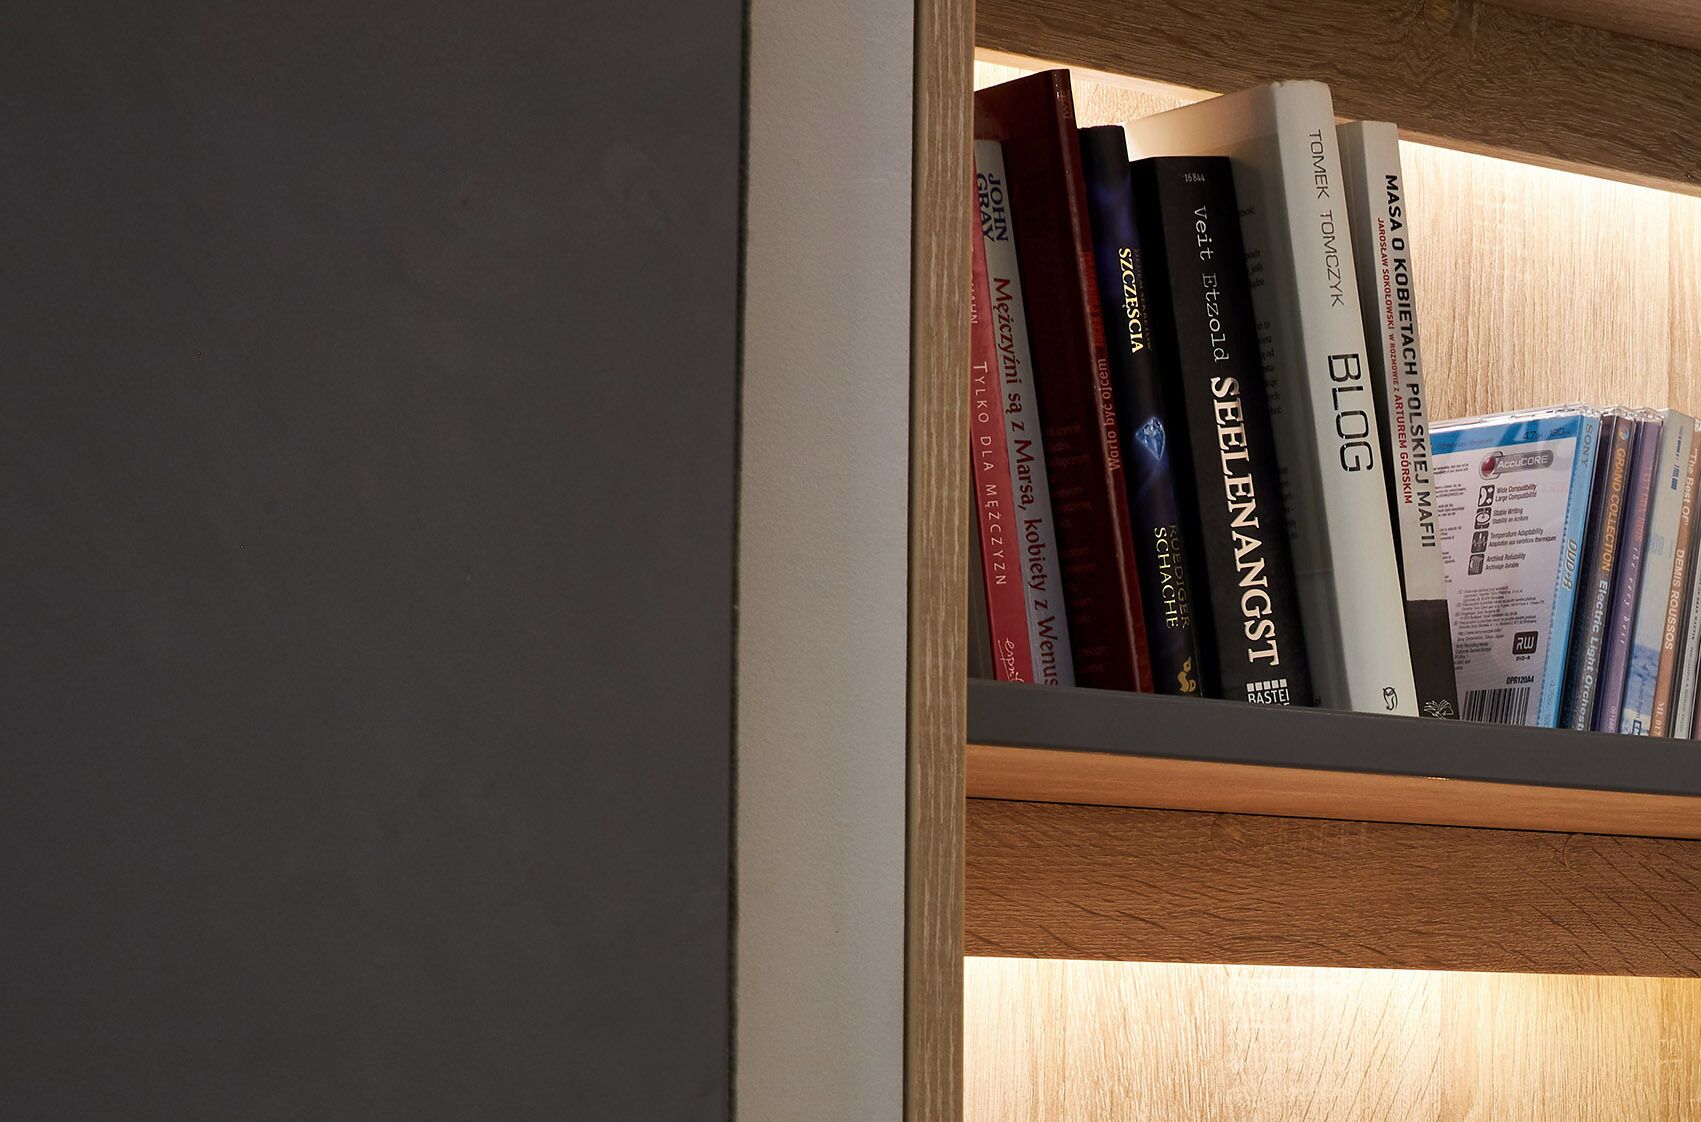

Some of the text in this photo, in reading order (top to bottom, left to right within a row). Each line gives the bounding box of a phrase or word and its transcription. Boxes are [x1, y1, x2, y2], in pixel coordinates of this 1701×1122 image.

[977, 173, 995, 242] GRAY
[988, 173, 1008, 242] JOHN
[1309, 129, 1344, 307] TOMEK TOMCZYK
[1378, 218, 1388, 267] JAROSŁAW
[1194, 205, 1230, 363] Veit Etzold
[1382, 269, 1395, 330] SOKOŁOWSKI
[993, 277, 1022, 384] Mężczyźni
[1385, 174, 1436, 548] MASA O KOBIETACH POLSKIEJ MAFII
[1097, 358, 1113, 400] ojcem
[1390, 343, 1399, 385] ROZMOWIE
[1005, 392, 1022, 414] są
[1010, 421, 1025, 433] z
[1328, 352, 1374, 473] BLOG
[1393, 394, 1407, 449] ARTUREM
[972, 361, 1007, 585] TYLKO DLA MĘŻCZYZN
[1014, 439, 1035, 511] Marsa,
[1107, 431, 1121, 471] Warto
[1400, 452, 1413, 504] GÓRSKIM
[1581, 423, 1593, 469] SONY
[1210, 376, 1280, 667] SEELENANGST
[1601, 447, 1626, 571] GRAND COLLECTION
[1682, 478, 1694, 504] Best
[1024, 518, 1048, 592] kobiety
[1154, 527, 1179, 630] SCHACHE
[1036, 599, 1048, 610] z
[1593, 580, 1608, 634] Electric
[1664, 550, 1686, 650] DEMIS ROUSSOS
[1586, 636, 1599, 672] Light
